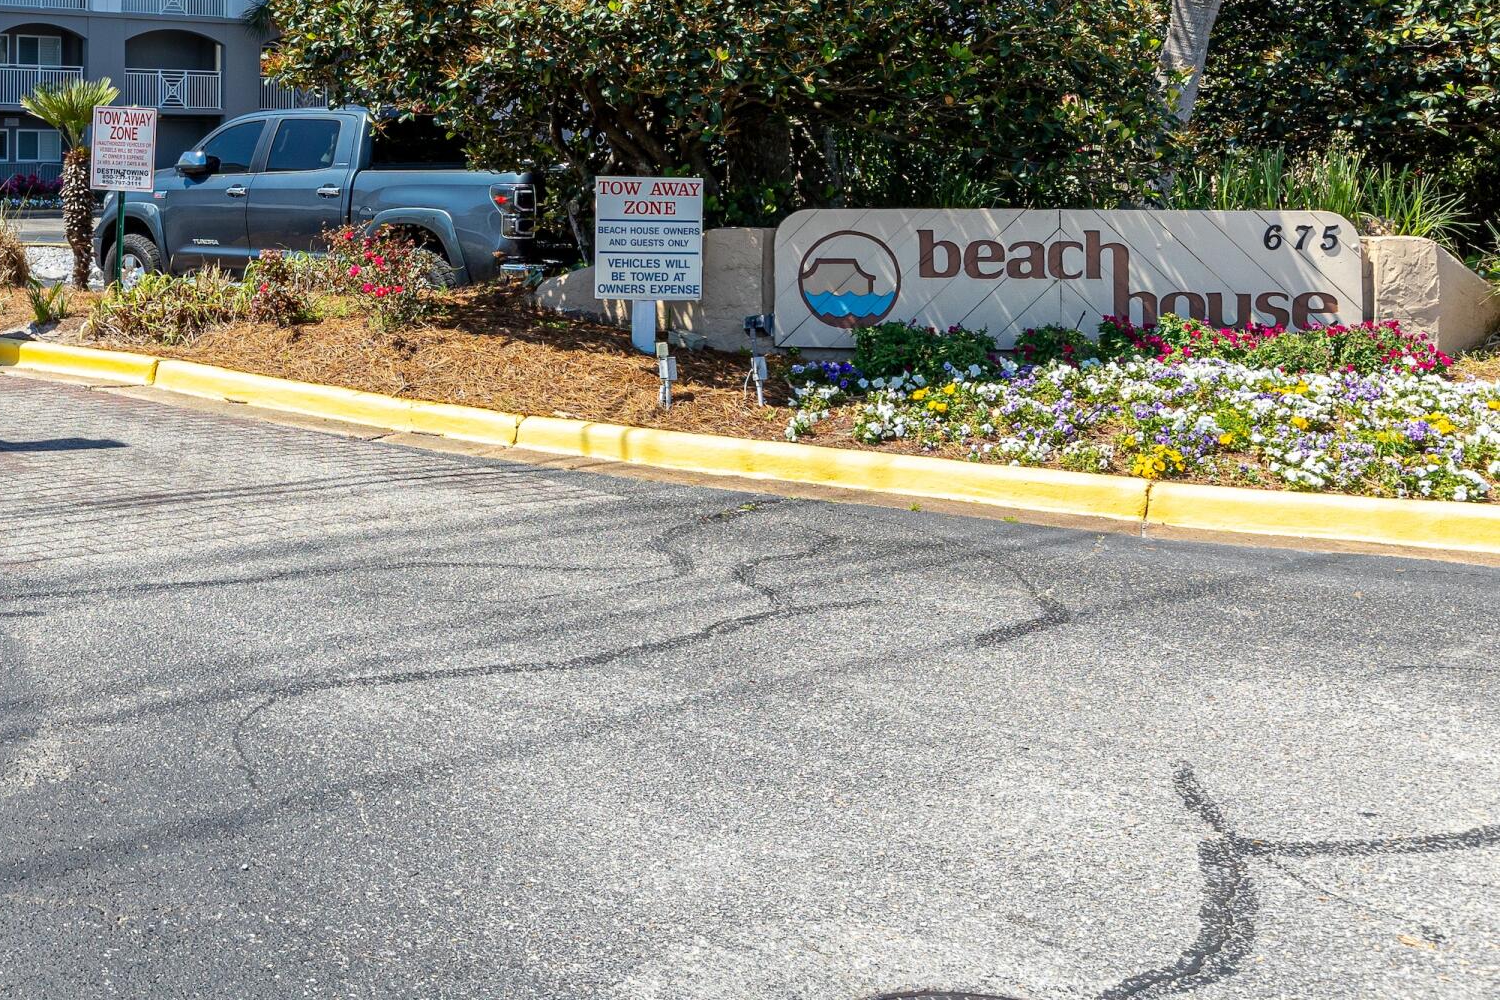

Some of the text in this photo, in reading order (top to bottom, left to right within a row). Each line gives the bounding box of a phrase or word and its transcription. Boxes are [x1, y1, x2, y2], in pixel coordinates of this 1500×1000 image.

[98, 111, 152, 127] TOW AWAY
[110, 126, 138, 140] ZONE
[599, 182, 700, 196] TOW AWAY
[624, 201, 676, 215] ZONE
[631, 227, 659, 235] HOUSE
[1263, 224, 1339, 251] 675
[631, 239, 664, 247] GUESTS
[917, 229, 1129, 280] beach
[608, 259, 690, 268] VEHICLES WILL
[612, 272, 686, 281] BE TOWED AT
[598, 284, 699, 294] OWNERS EXPENSE
[1113, 265, 1338, 331] house
